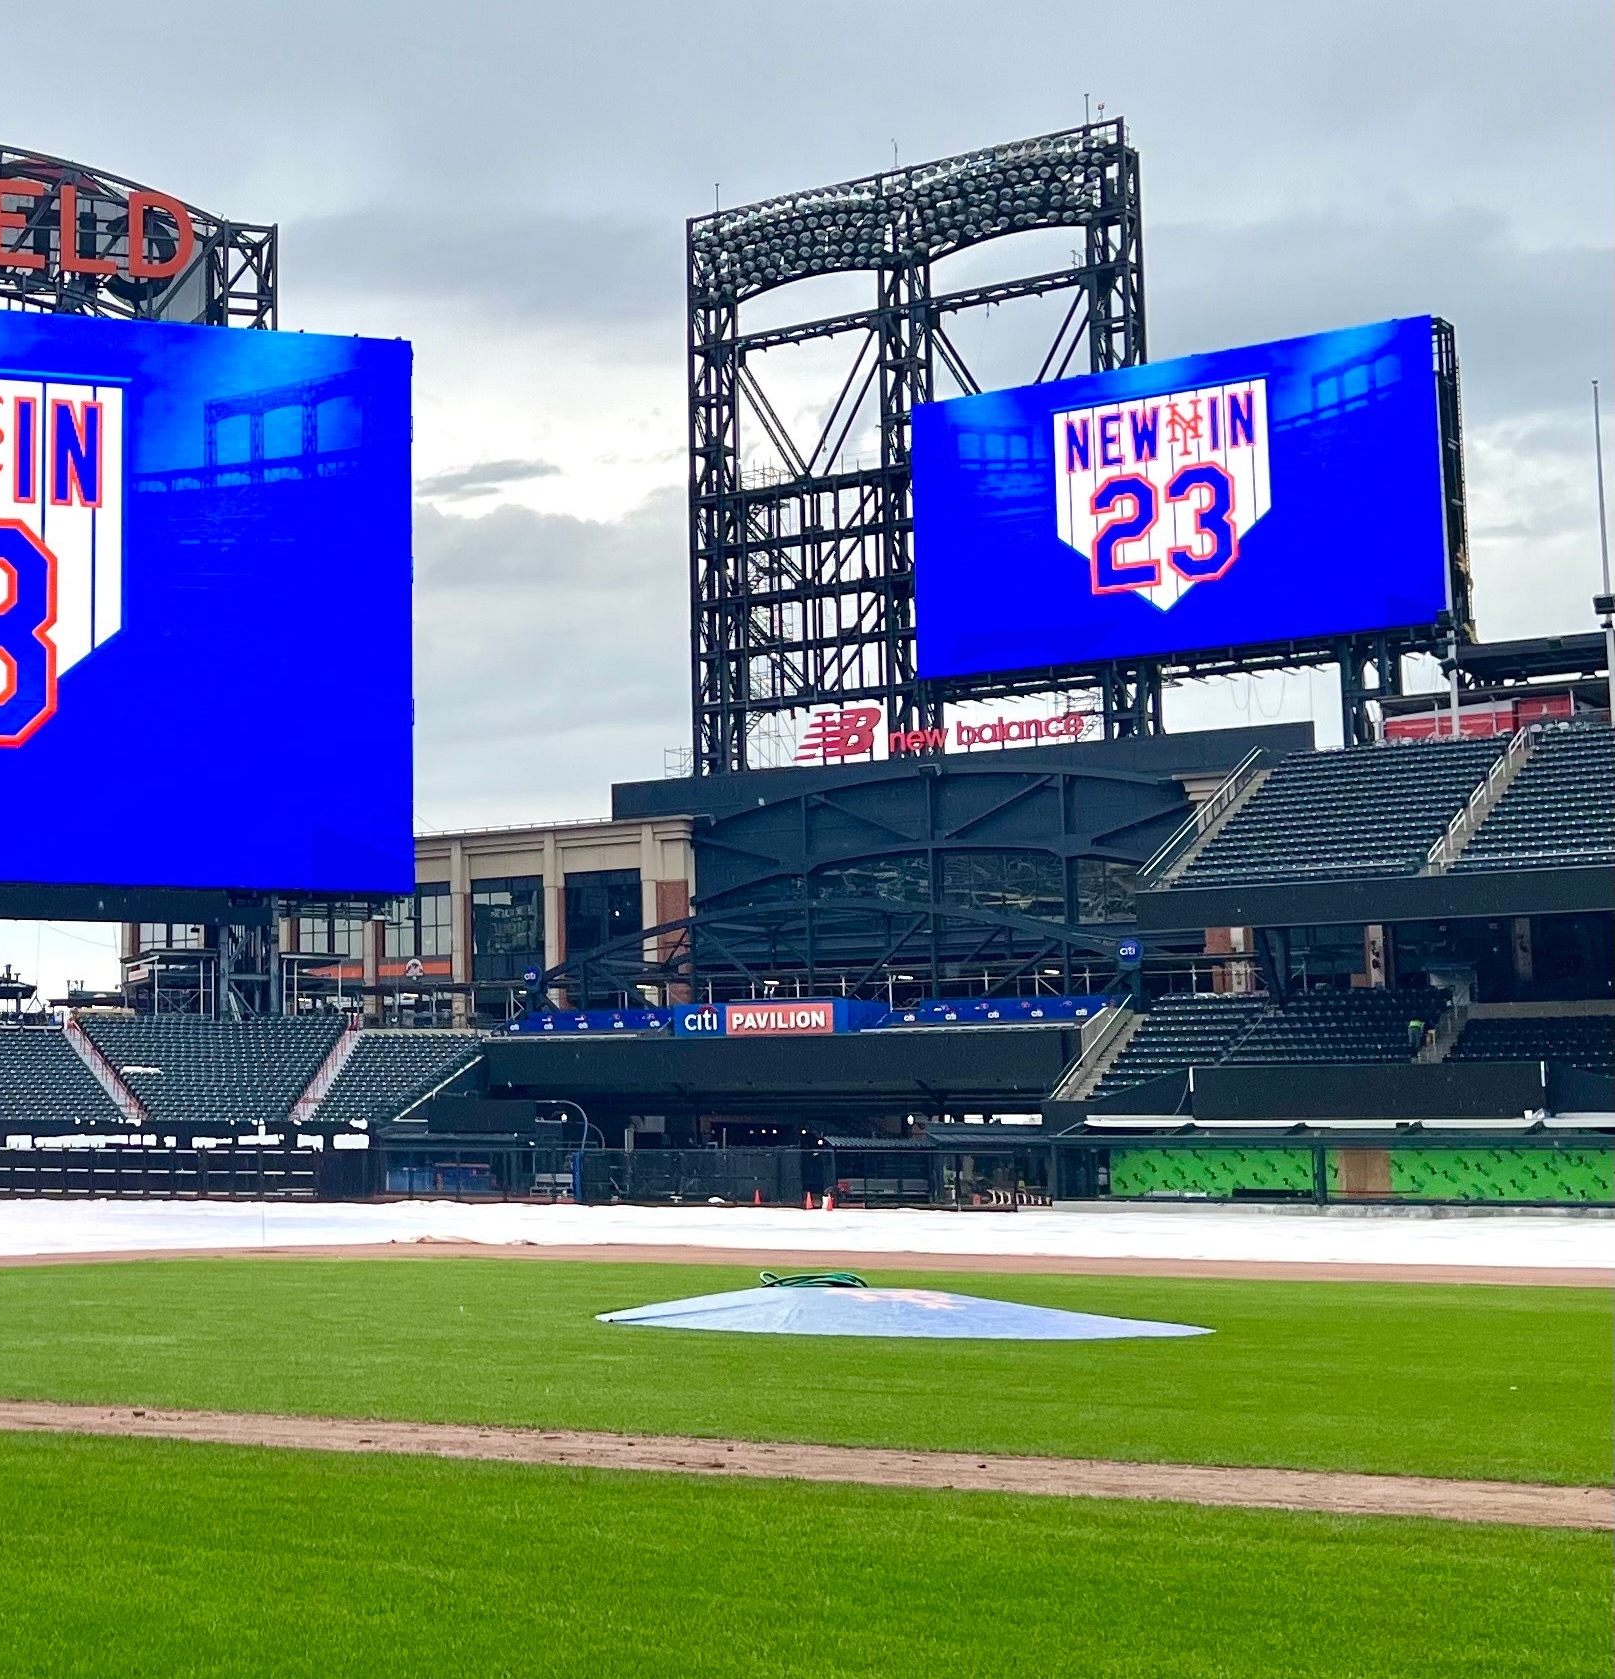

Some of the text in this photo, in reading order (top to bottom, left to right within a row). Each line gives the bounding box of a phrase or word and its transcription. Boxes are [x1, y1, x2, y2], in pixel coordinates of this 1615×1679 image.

[13, 396, 103, 508] IN
[1064, 405, 1161, 474] NEW
[1207, 390, 1257, 452] IN
[1089, 460, 1240, 595] 23
[889, 712, 1086, 753] new balance
[684, 1009, 826, 1031] citi PAVILION
